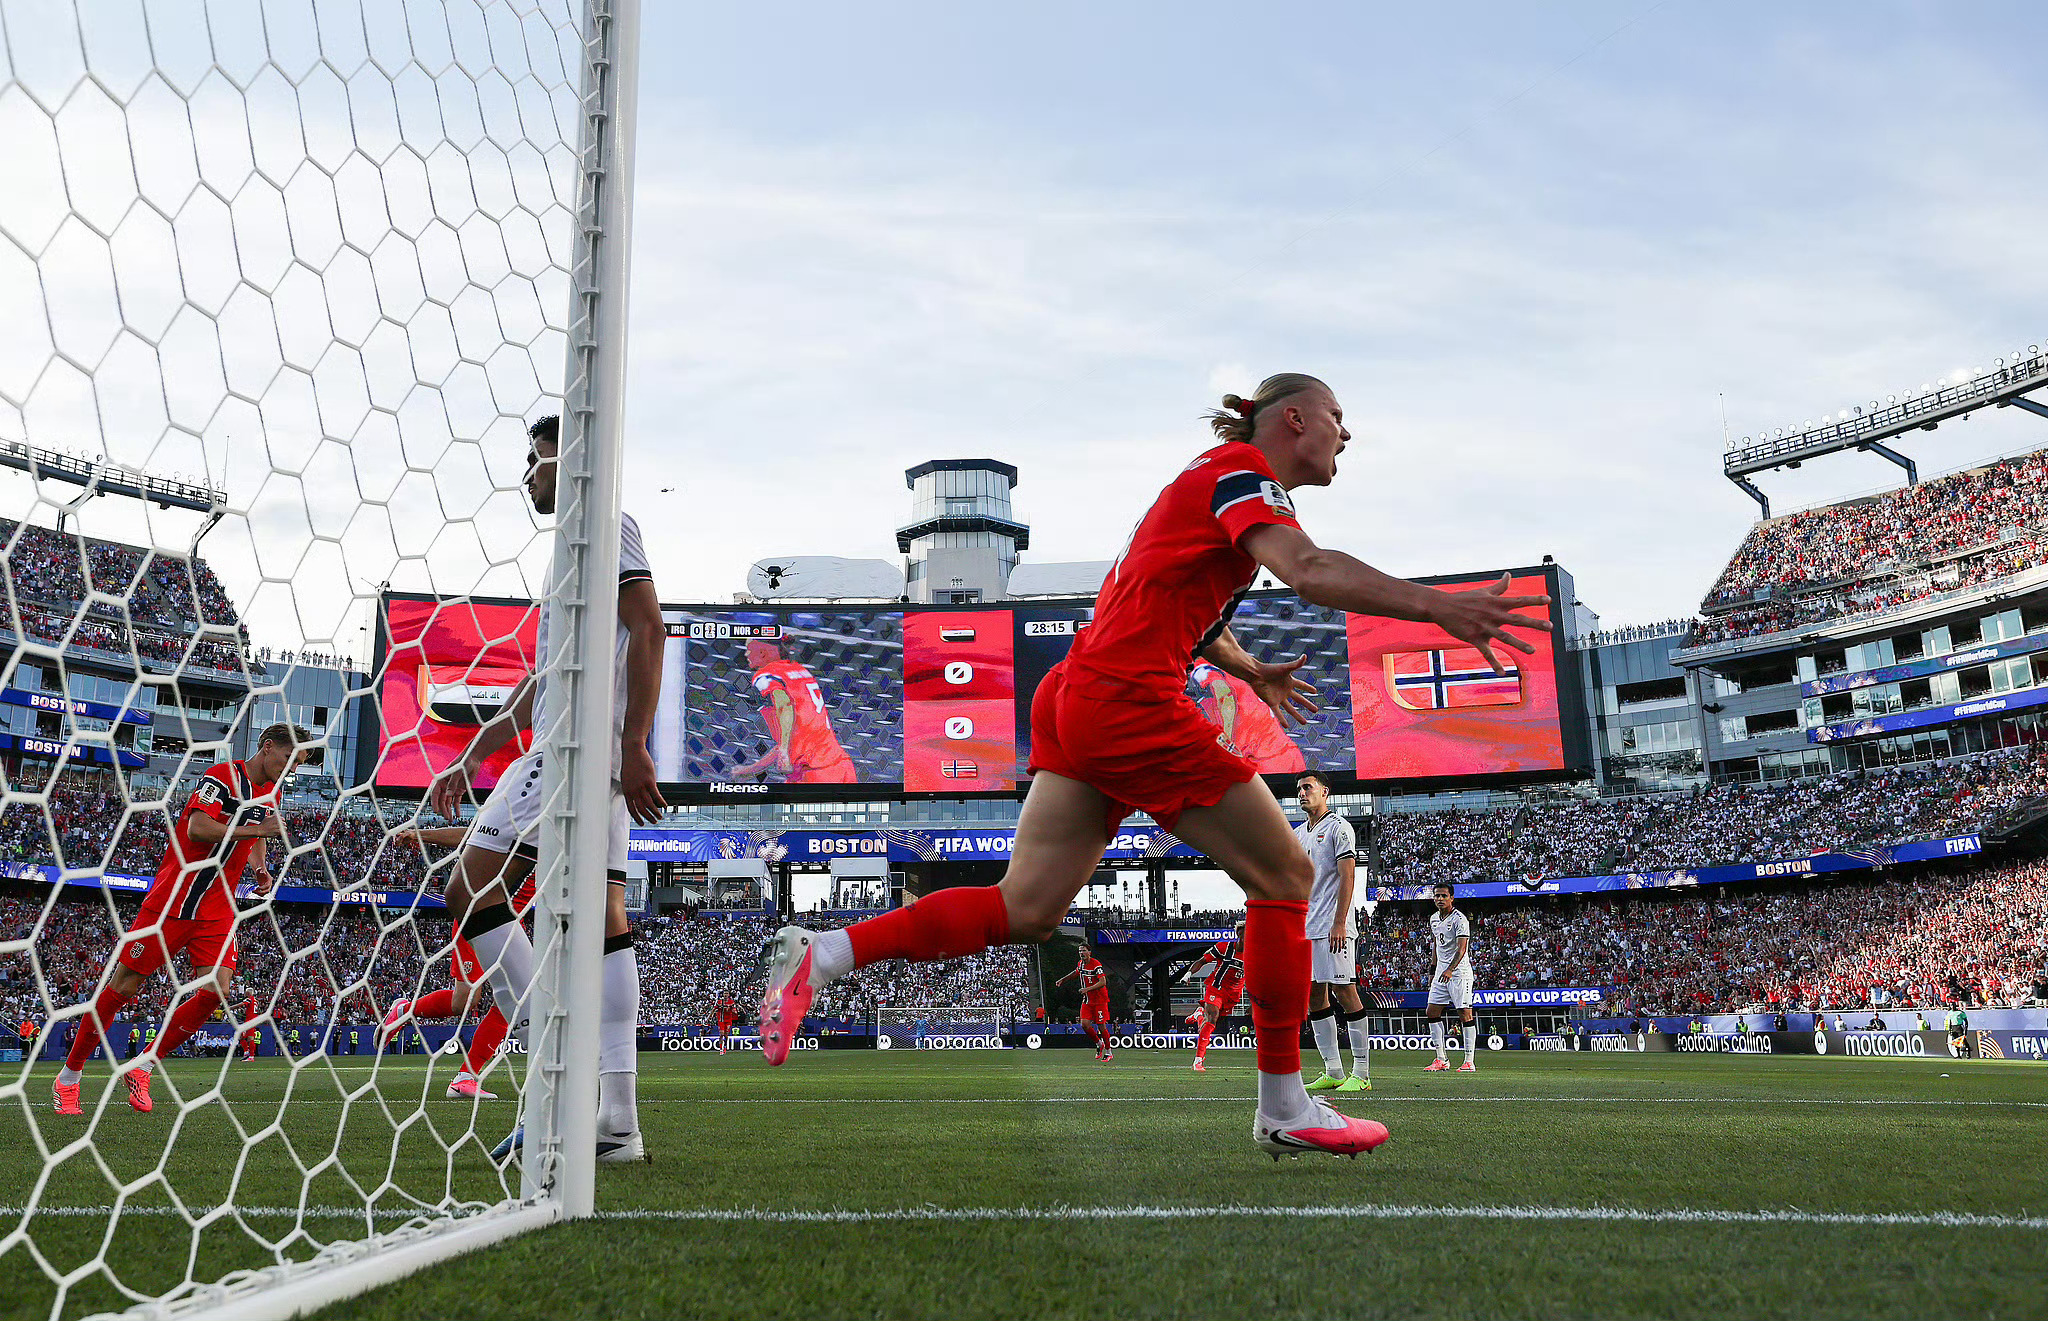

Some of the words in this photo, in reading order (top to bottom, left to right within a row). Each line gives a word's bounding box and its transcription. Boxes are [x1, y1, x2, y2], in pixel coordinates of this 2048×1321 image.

[670, 625, 685, 635] IRQ
[693, 626, 701, 636] 0
[719, 626, 727, 636] 0
[733, 626, 751, 636] NOR
[1032, 623, 1065, 633] 28:15
[709, 782, 769, 793] Hisense
[477, 825, 500, 837] JAKO
[808, 838, 887, 854] BOSTON
[935, 838, 974, 852] FIFA
[975, 837, 1015, 852] WOR
[1105, 834, 1150, 850] 26
[1945, 838, 1975, 854] FIFA
[1756, 859, 1812, 877] BOSTON
[1062, 916, 1081, 924] TON
[1167, 931, 1187, 940] FIFA
[1188, 931, 1223, 940] WORLD
[1483, 991, 1531, 1004] WORLD
[1532, 990, 1560, 1003] CUP
[1561, 989, 1601, 1002] 2026
[1109, 1033, 1176, 1049] ootball
[1182, 1035, 1196, 1049] is
[1368, 1036, 1460, 1050] motoroa
[1529, 1036, 1567, 1051] motorola
[1591, 1034, 1628, 1051] motorola
[1731, 1032, 1772, 1054] calling
[1844, 1031, 1925, 1057] motorola
[2011, 1036, 2041, 1054] FIFA
